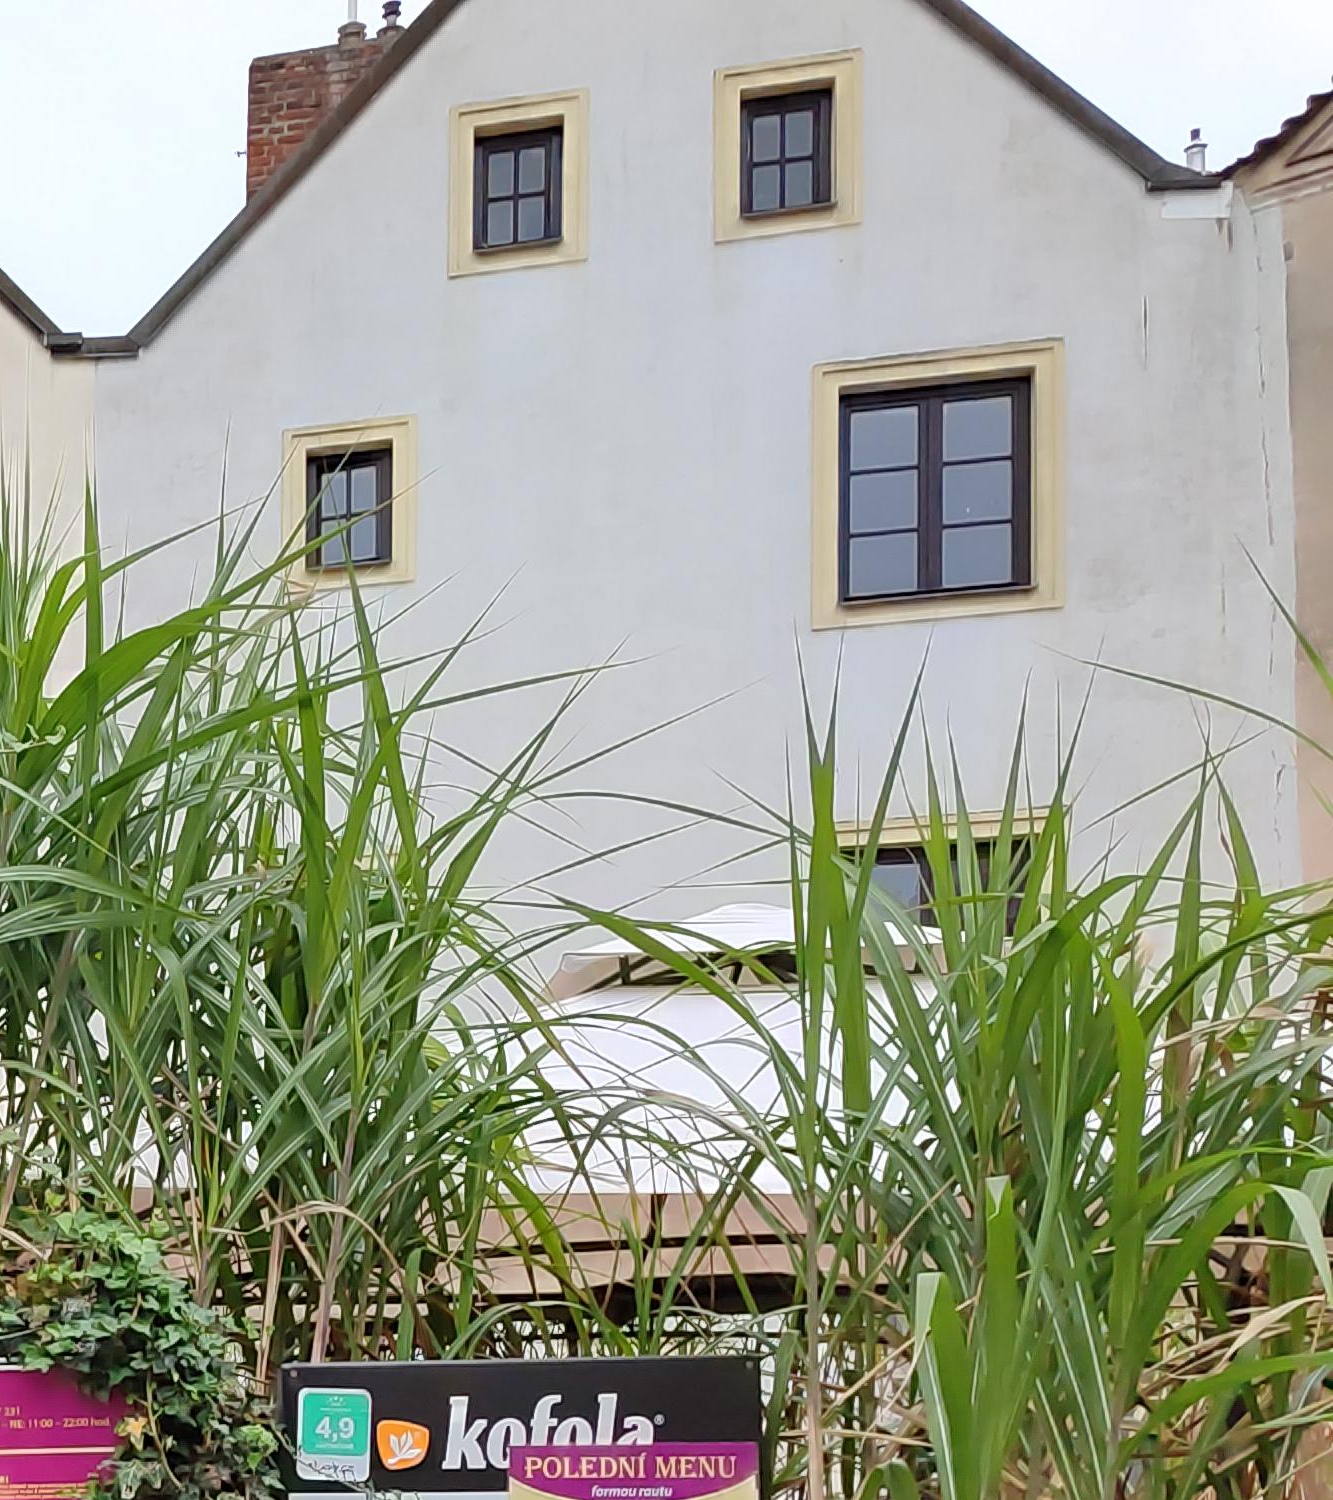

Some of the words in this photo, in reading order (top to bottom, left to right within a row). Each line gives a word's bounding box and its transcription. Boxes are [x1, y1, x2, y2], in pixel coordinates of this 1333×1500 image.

[316, 1416, 354, 1442] 4,9
[525, 1452, 647, 1479] POLEDNÍ
[655, 1456, 736, 1479] MENU
[592, 1485, 636, 1497] formou
[639, 1486, 672, 1497] rautu
